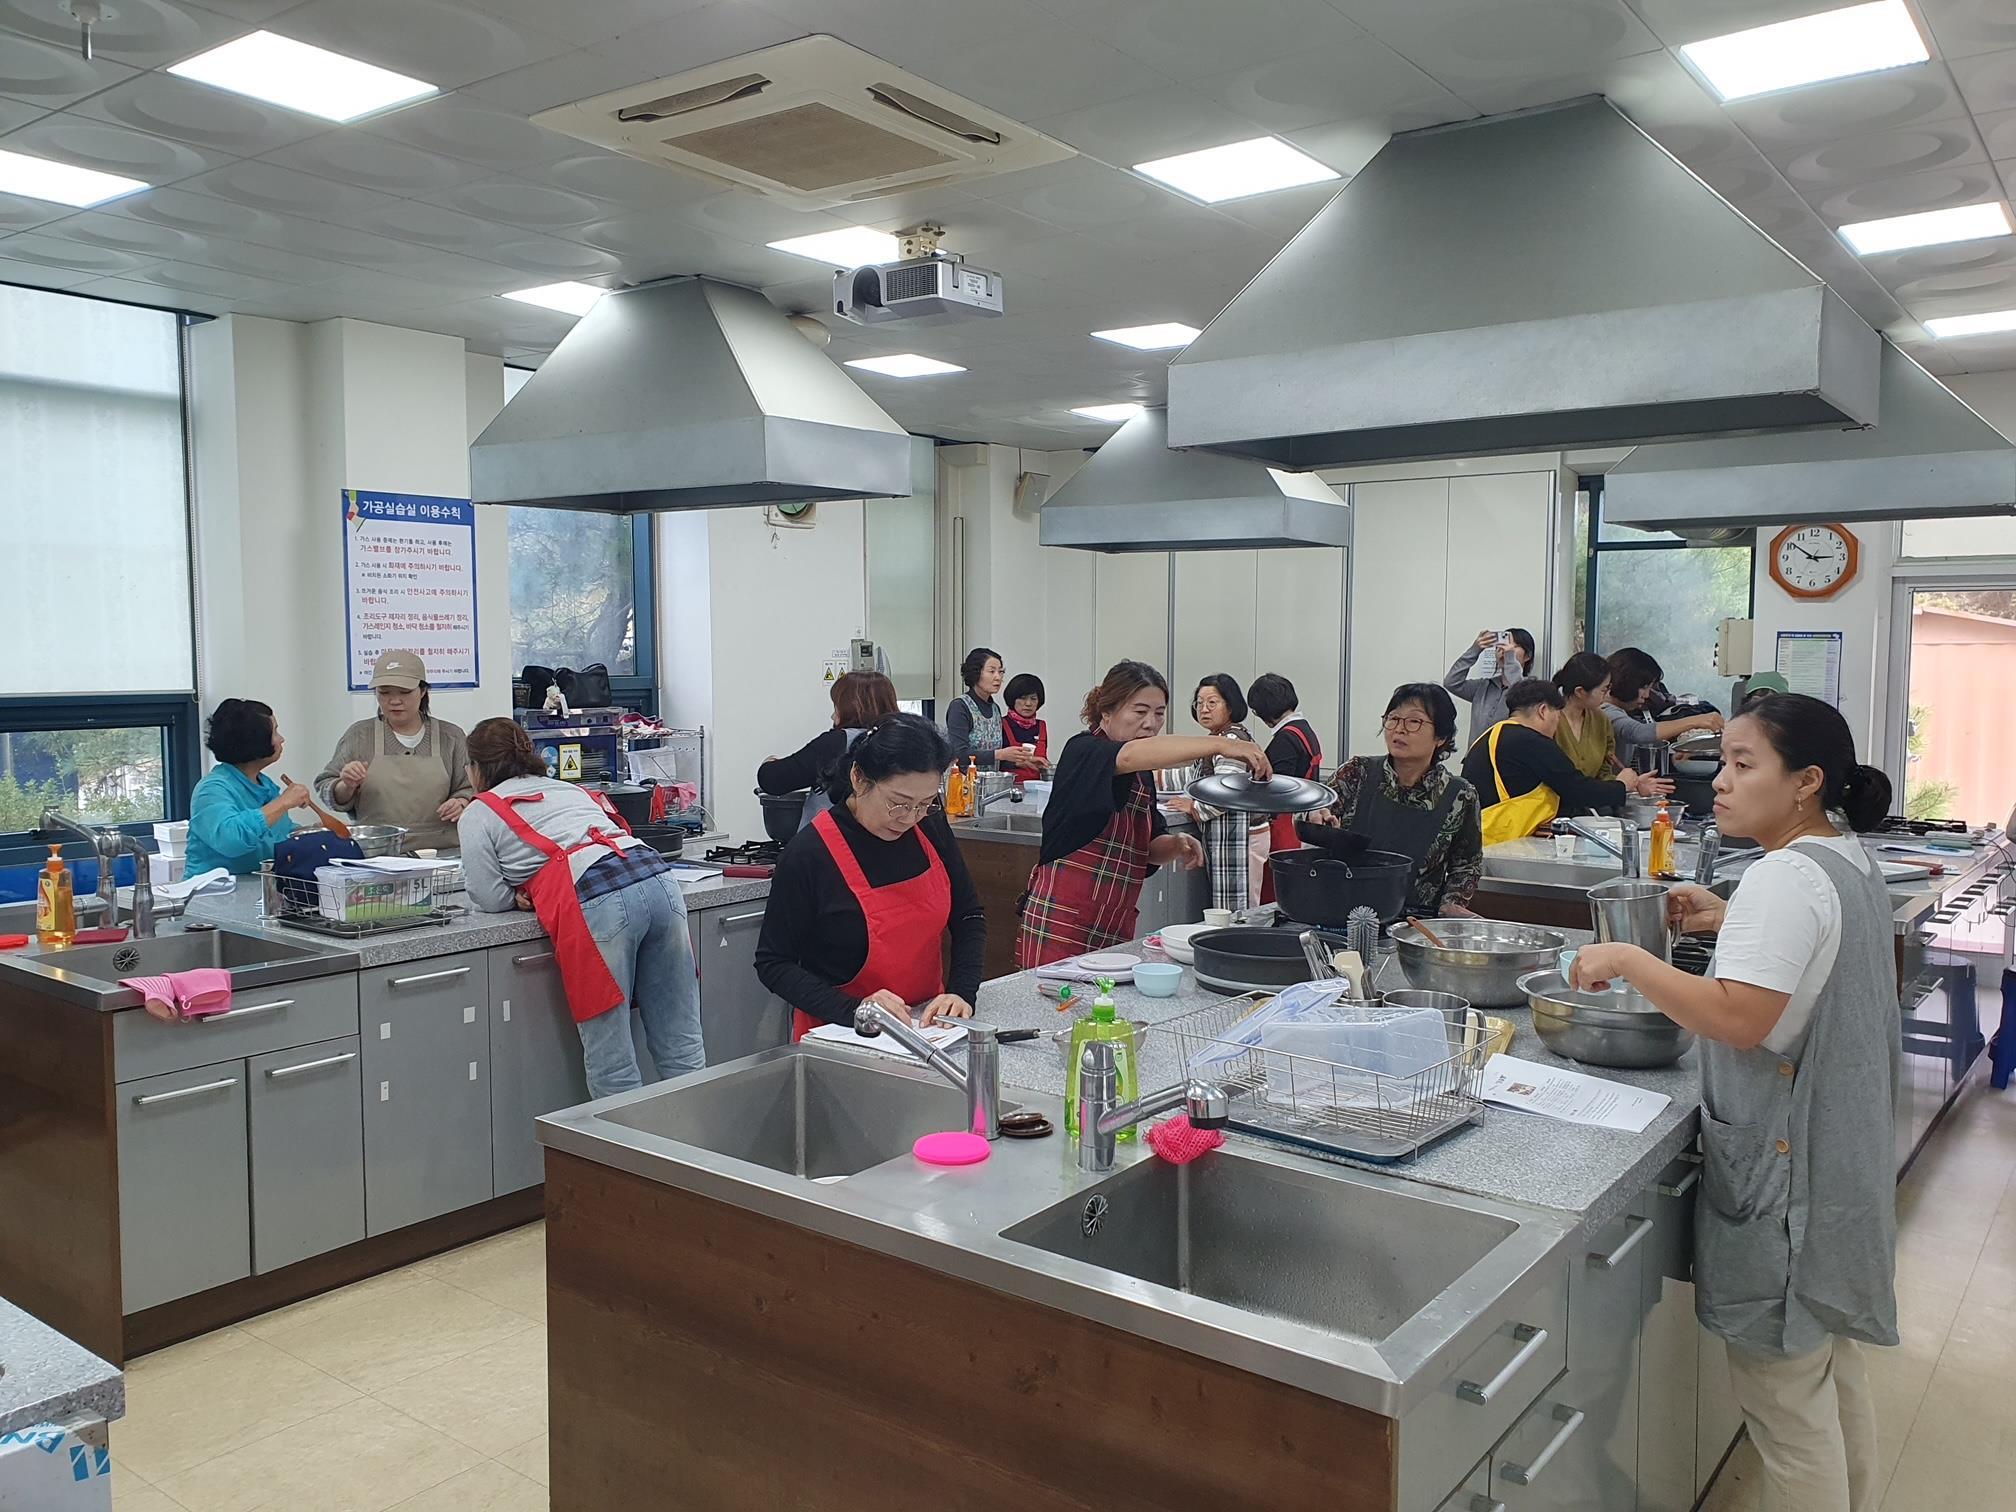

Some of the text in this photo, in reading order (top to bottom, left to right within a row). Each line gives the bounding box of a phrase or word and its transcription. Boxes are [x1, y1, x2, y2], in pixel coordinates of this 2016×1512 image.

[363, 500, 460, 519] 가공실습실 이용수칙
[1798, 533, 1805, 541] 11
[1810, 529, 1820, 537] 12
[1829, 532, 1832, 540] 1
[360, 545, 392, 553] 가스밸브를
[1786, 542, 1796, 550] 10
[1836, 541, 1842, 549] 2
[408, 562, 437, 571] 주의하시기
[1824, 575, 1830, 583] 5
